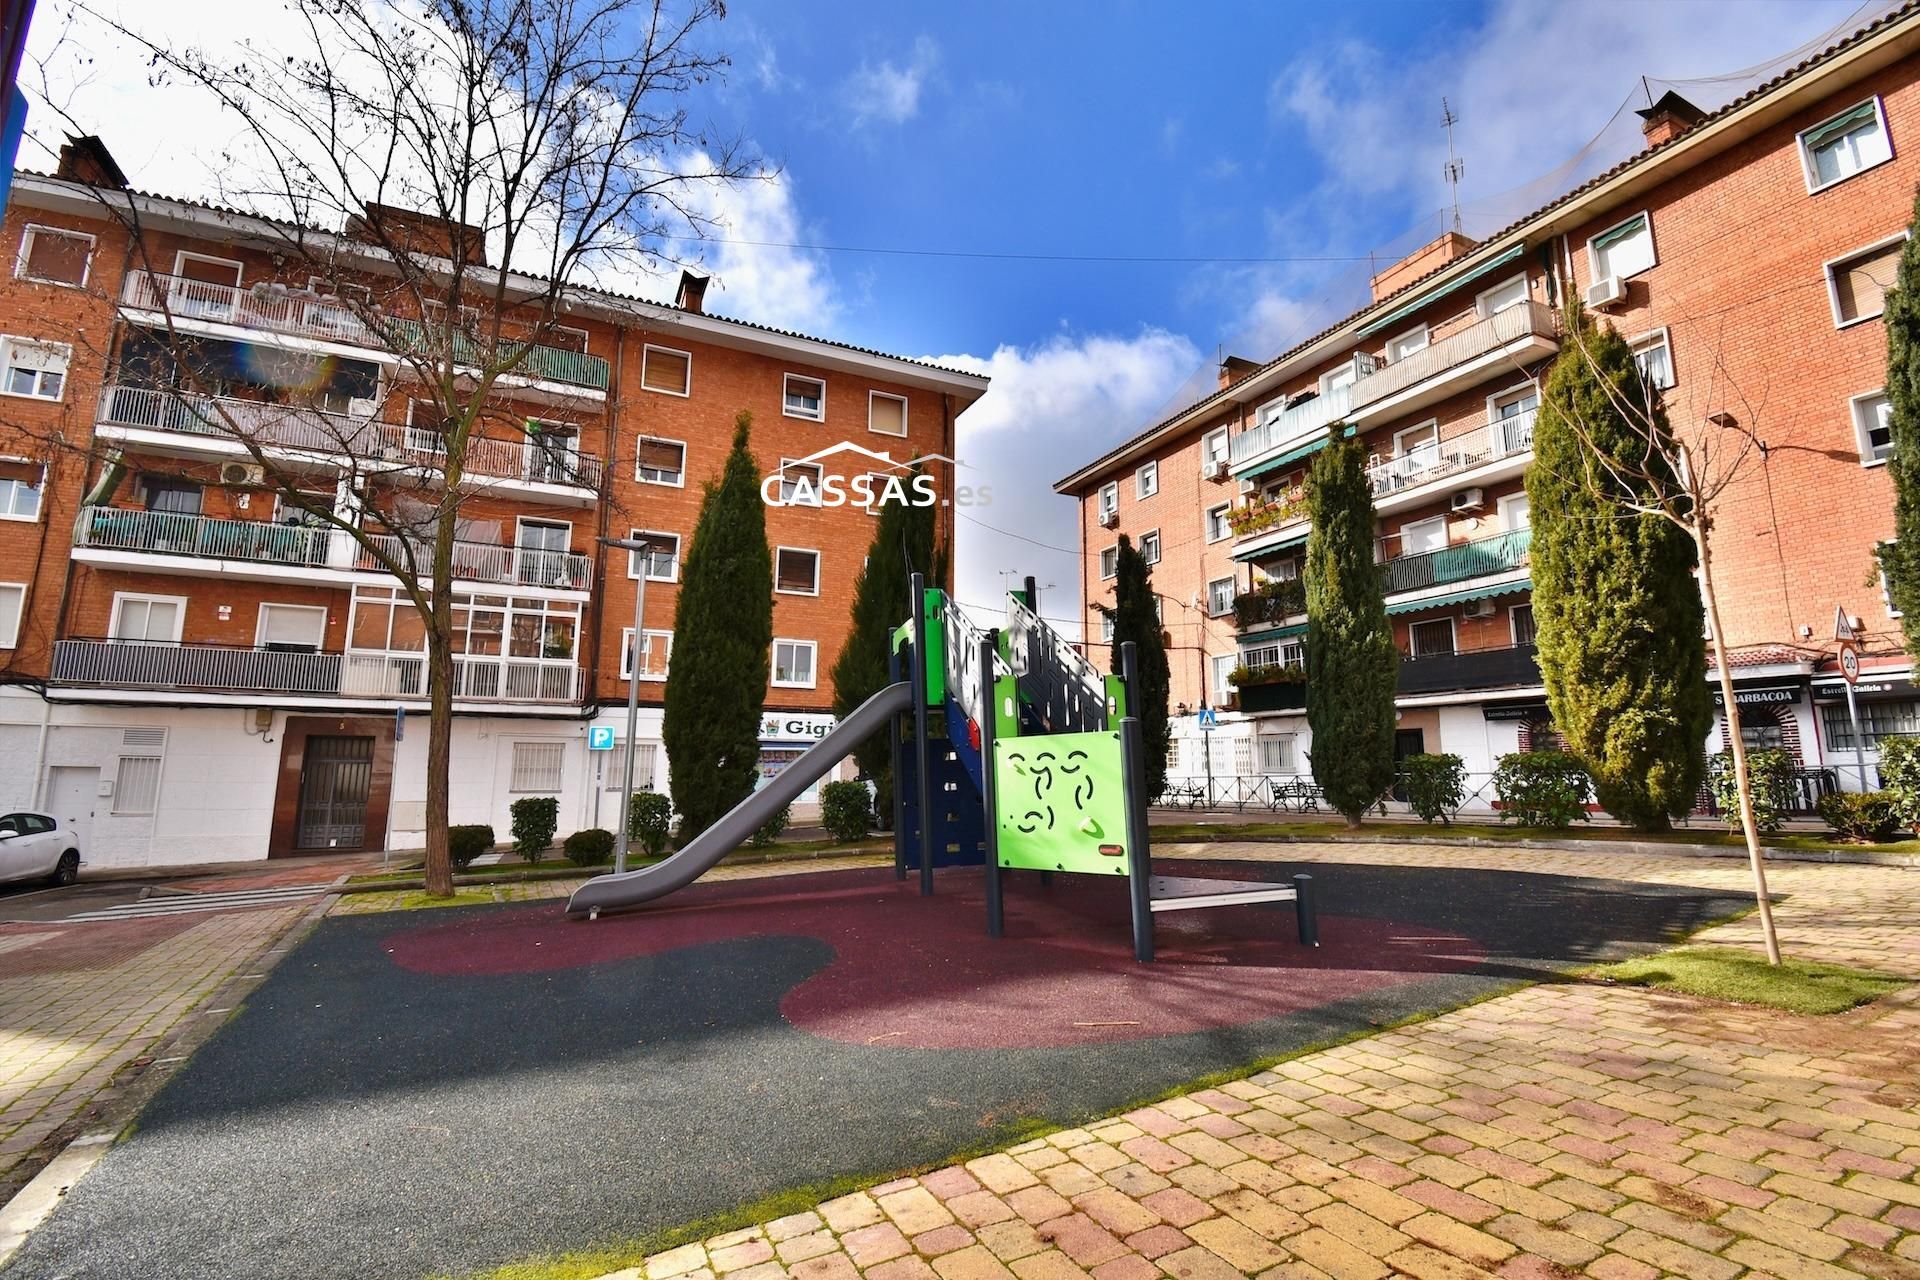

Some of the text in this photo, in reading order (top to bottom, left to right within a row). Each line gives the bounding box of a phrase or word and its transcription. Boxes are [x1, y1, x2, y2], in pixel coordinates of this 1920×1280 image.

[1844, 656, 1855, 669] 20
[1822, 684, 1881, 695] Estrell Galicia
[594, 729, 609, 747] P
